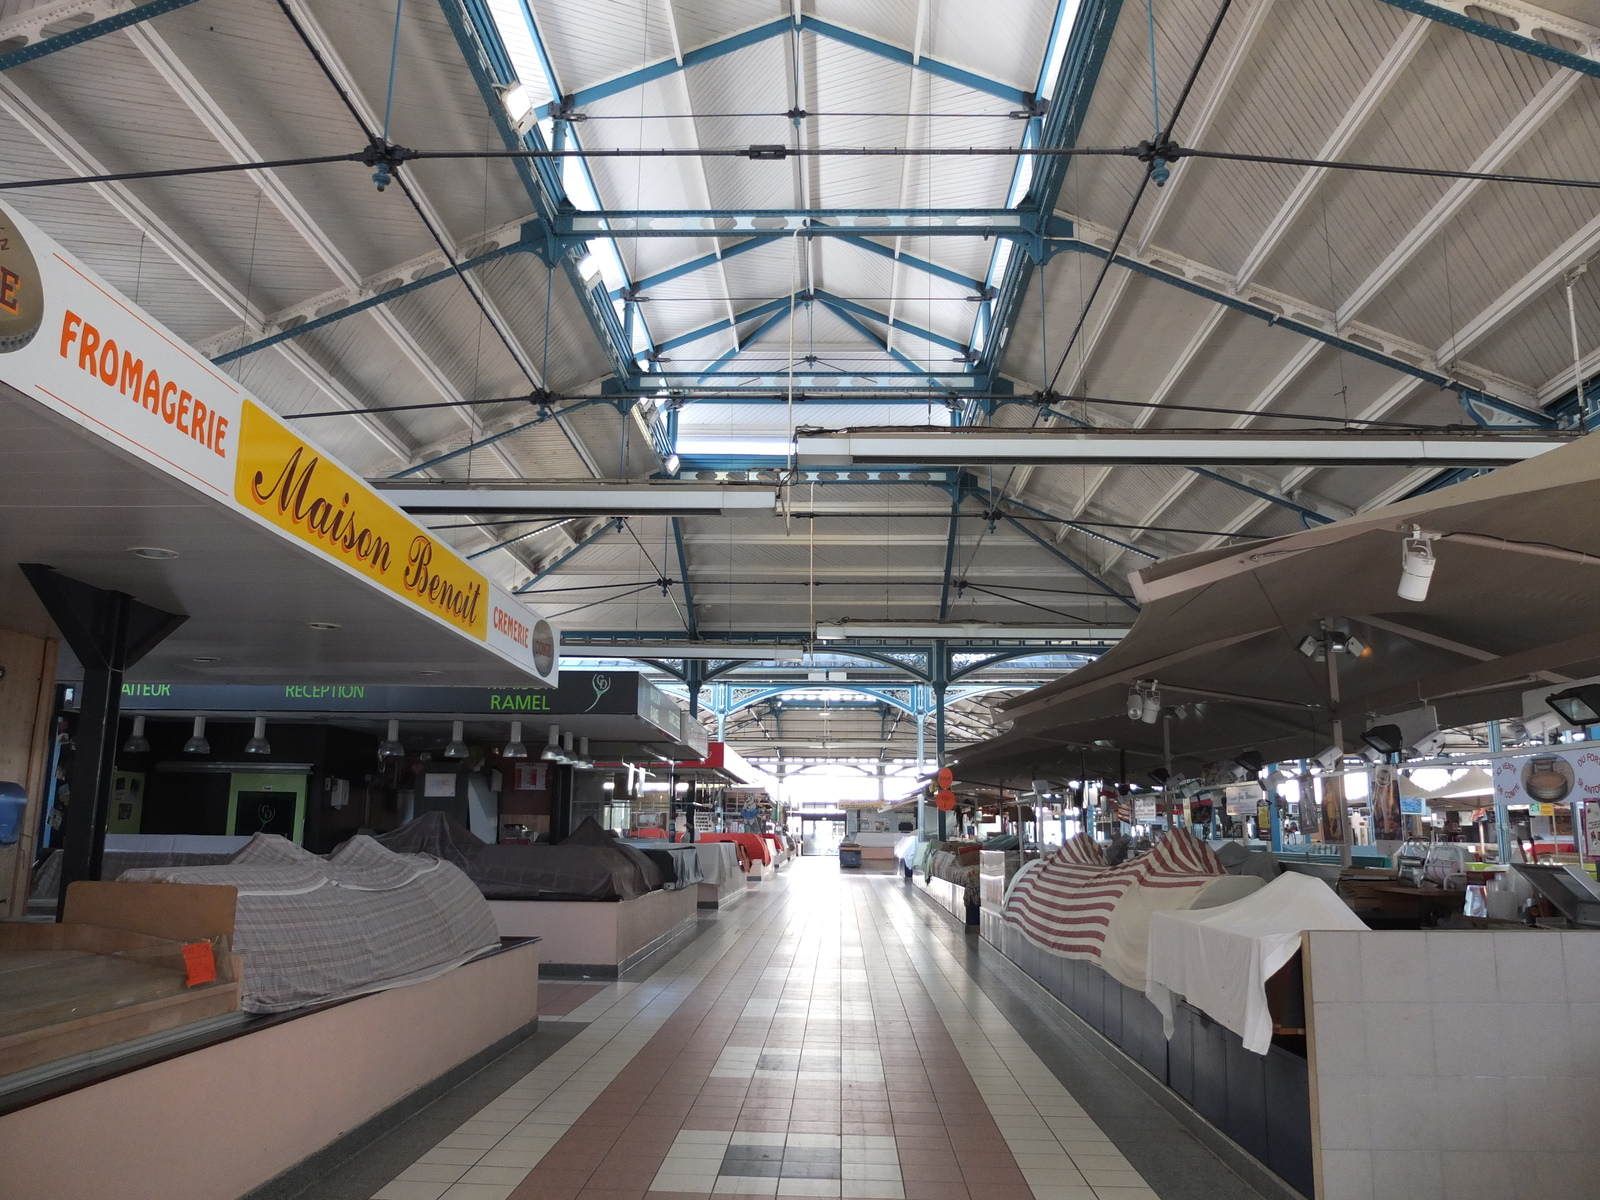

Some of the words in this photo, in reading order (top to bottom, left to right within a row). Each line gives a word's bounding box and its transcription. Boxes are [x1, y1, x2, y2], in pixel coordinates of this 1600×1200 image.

[60, 309, 229, 459] FROMAGERIE
[252, 446, 392, 575] Maison
[403, 535, 481, 627] Benoit
[493, 606, 530, 649] CREMERIE
[490, 694, 551, 710] RAMEL
[1502, 762, 1517, 775] VENTE
